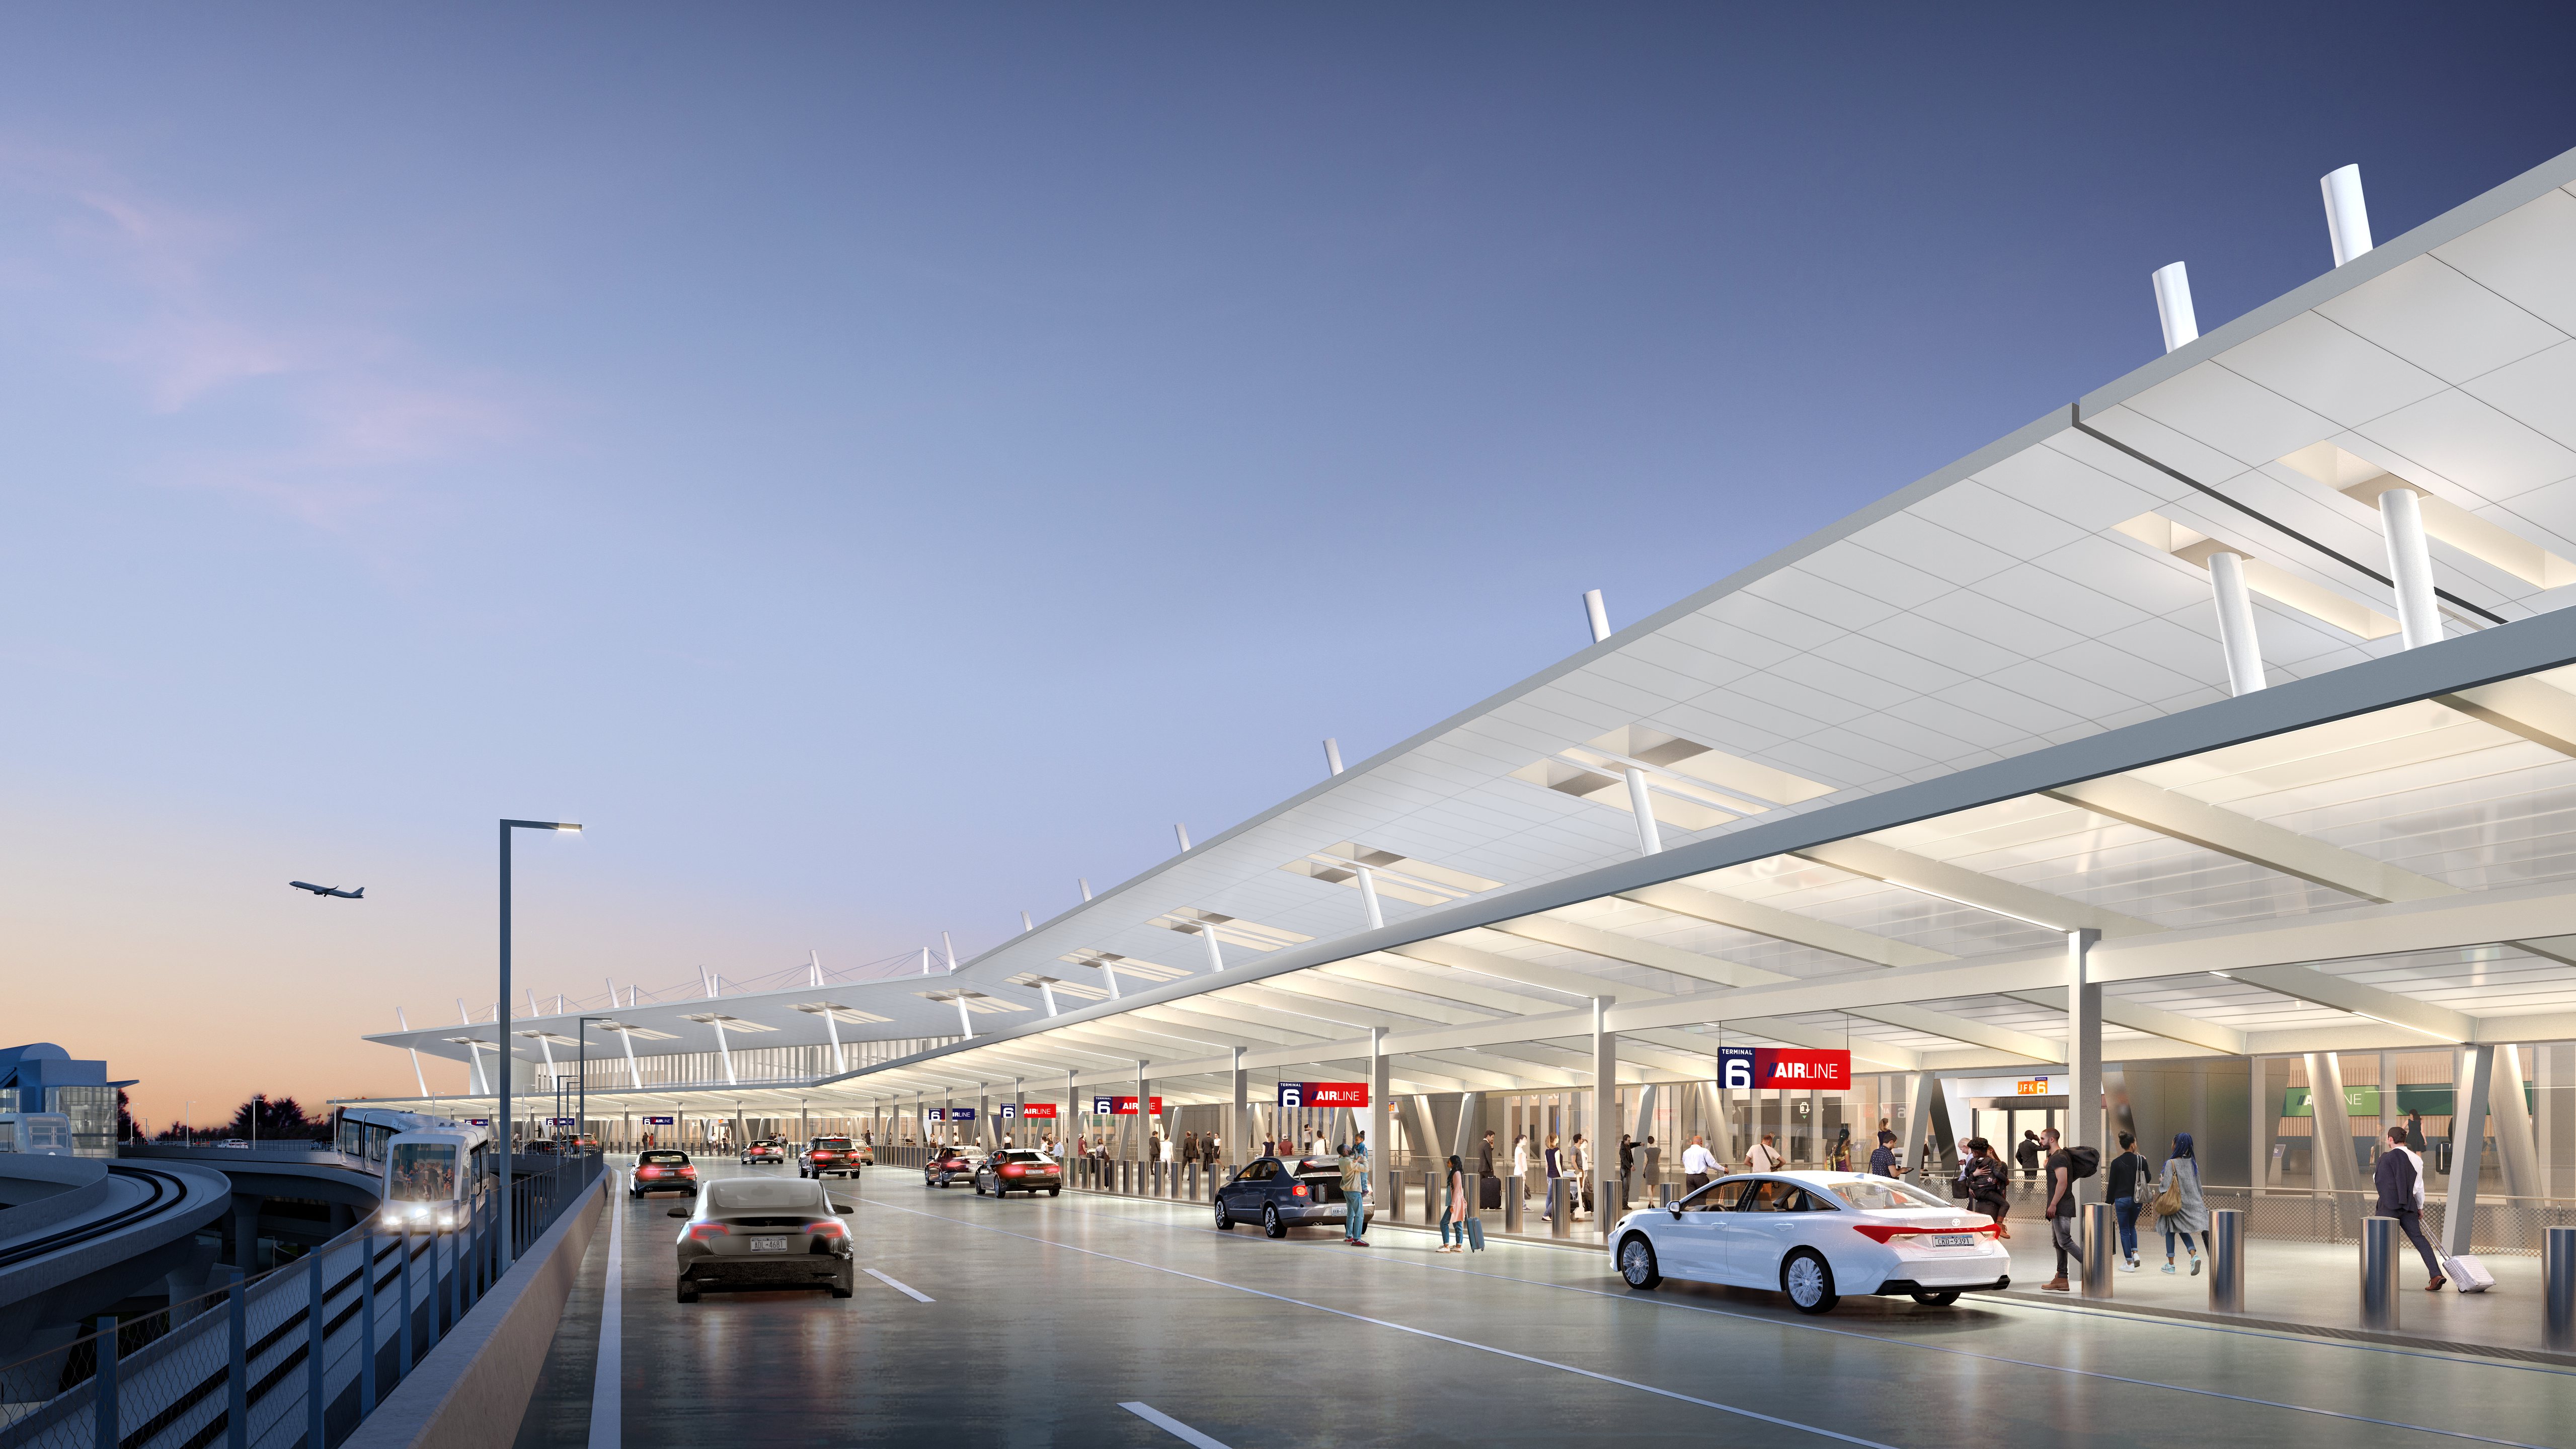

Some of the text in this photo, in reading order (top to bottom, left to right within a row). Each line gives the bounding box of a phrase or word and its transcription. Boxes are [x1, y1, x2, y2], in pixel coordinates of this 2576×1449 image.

[1726, 1059, 1751, 1089] 6
[1775, 1063, 1838, 1079] AIRLINE
[2018, 1082, 2046, 1094] JFK 6
[1283, 1089, 1300, 1107] 6
[1316, 1091, 1360, 1101] AIRLINE
[1003, 1107, 1014, 1118] 6
[1098, 1101, 1110, 1114] 6
[931, 1111, 940, 1120] 6
